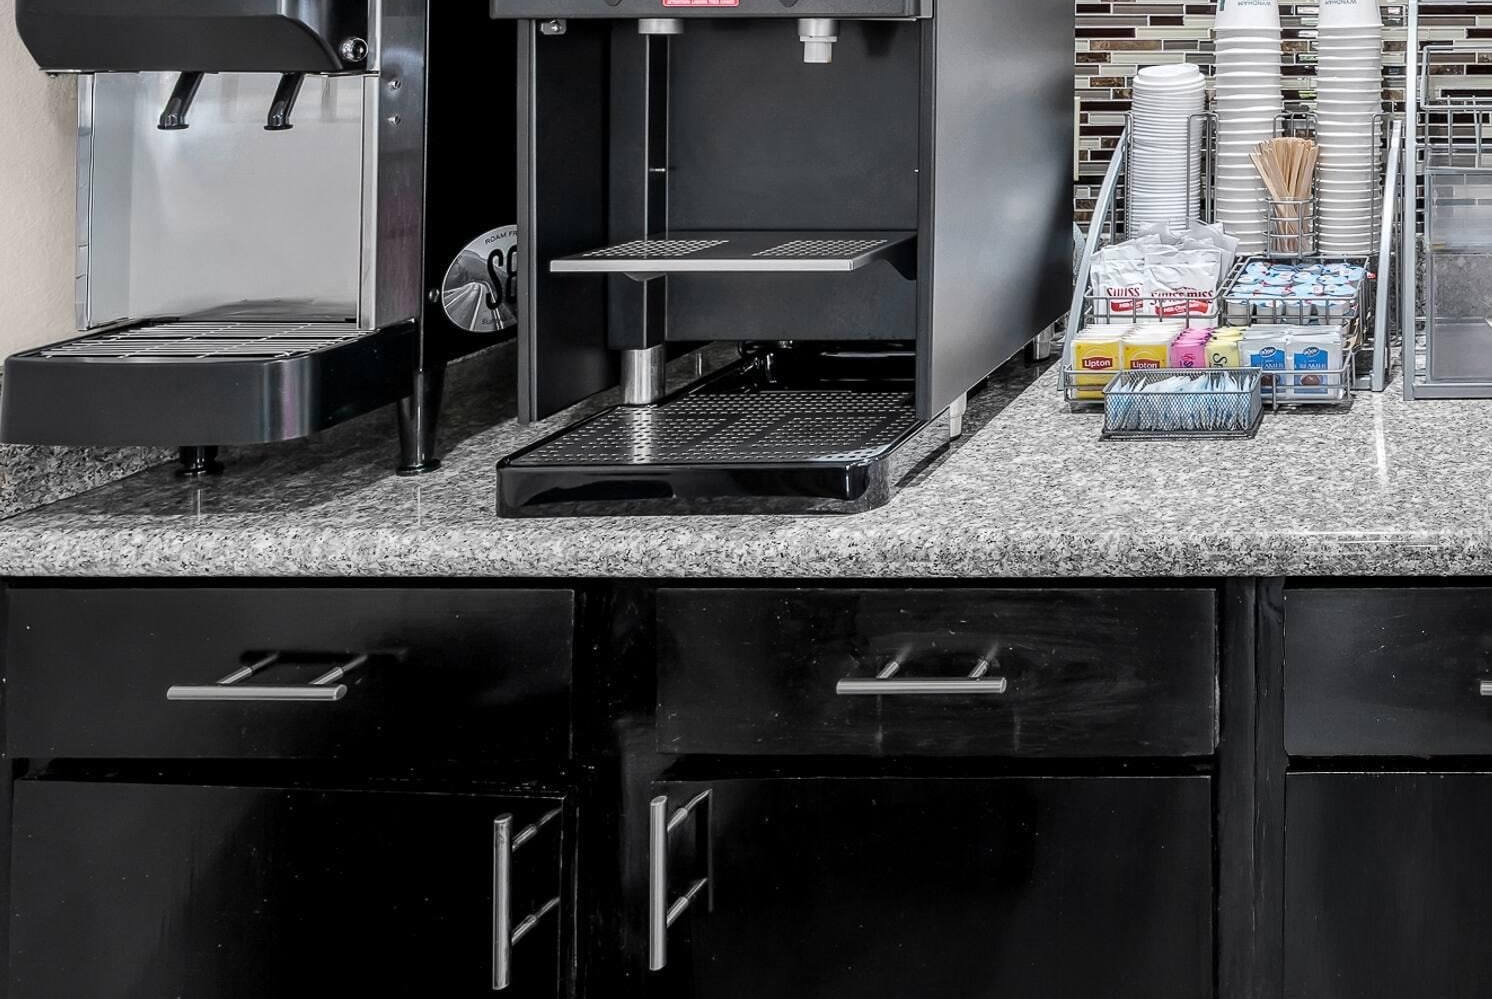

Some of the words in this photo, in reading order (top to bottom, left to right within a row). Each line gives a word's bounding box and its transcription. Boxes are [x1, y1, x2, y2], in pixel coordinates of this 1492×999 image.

[485, 231, 507, 245] ROAM
[1084, 358, 1111, 369] Lipton
[1132, 360, 1158, 369] Lipton
